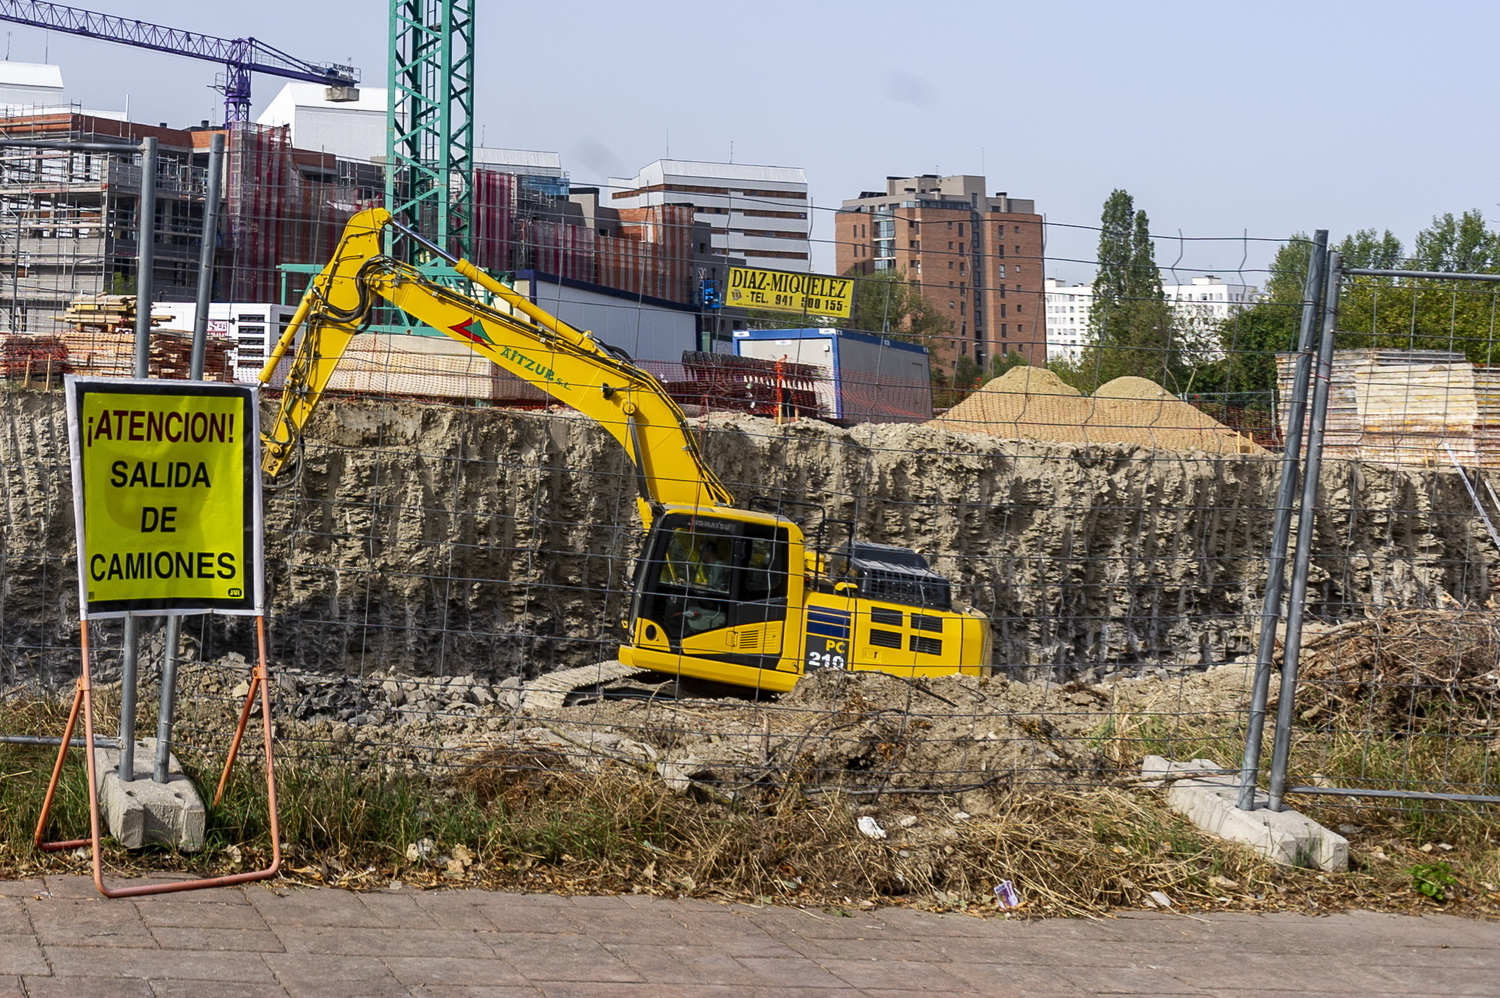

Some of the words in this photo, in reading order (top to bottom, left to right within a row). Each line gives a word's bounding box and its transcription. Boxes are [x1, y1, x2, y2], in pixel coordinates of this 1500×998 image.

[775, 294, 793, 307] 941
[87, 409, 235, 448] ¡ATENCION!
[110, 460, 211, 488] SALIDA
[140, 506, 178, 534] DE
[90, 551, 236, 582] CAMIONES
[808, 651, 845, 670] 210
[825, 639, 846, 654] PC
